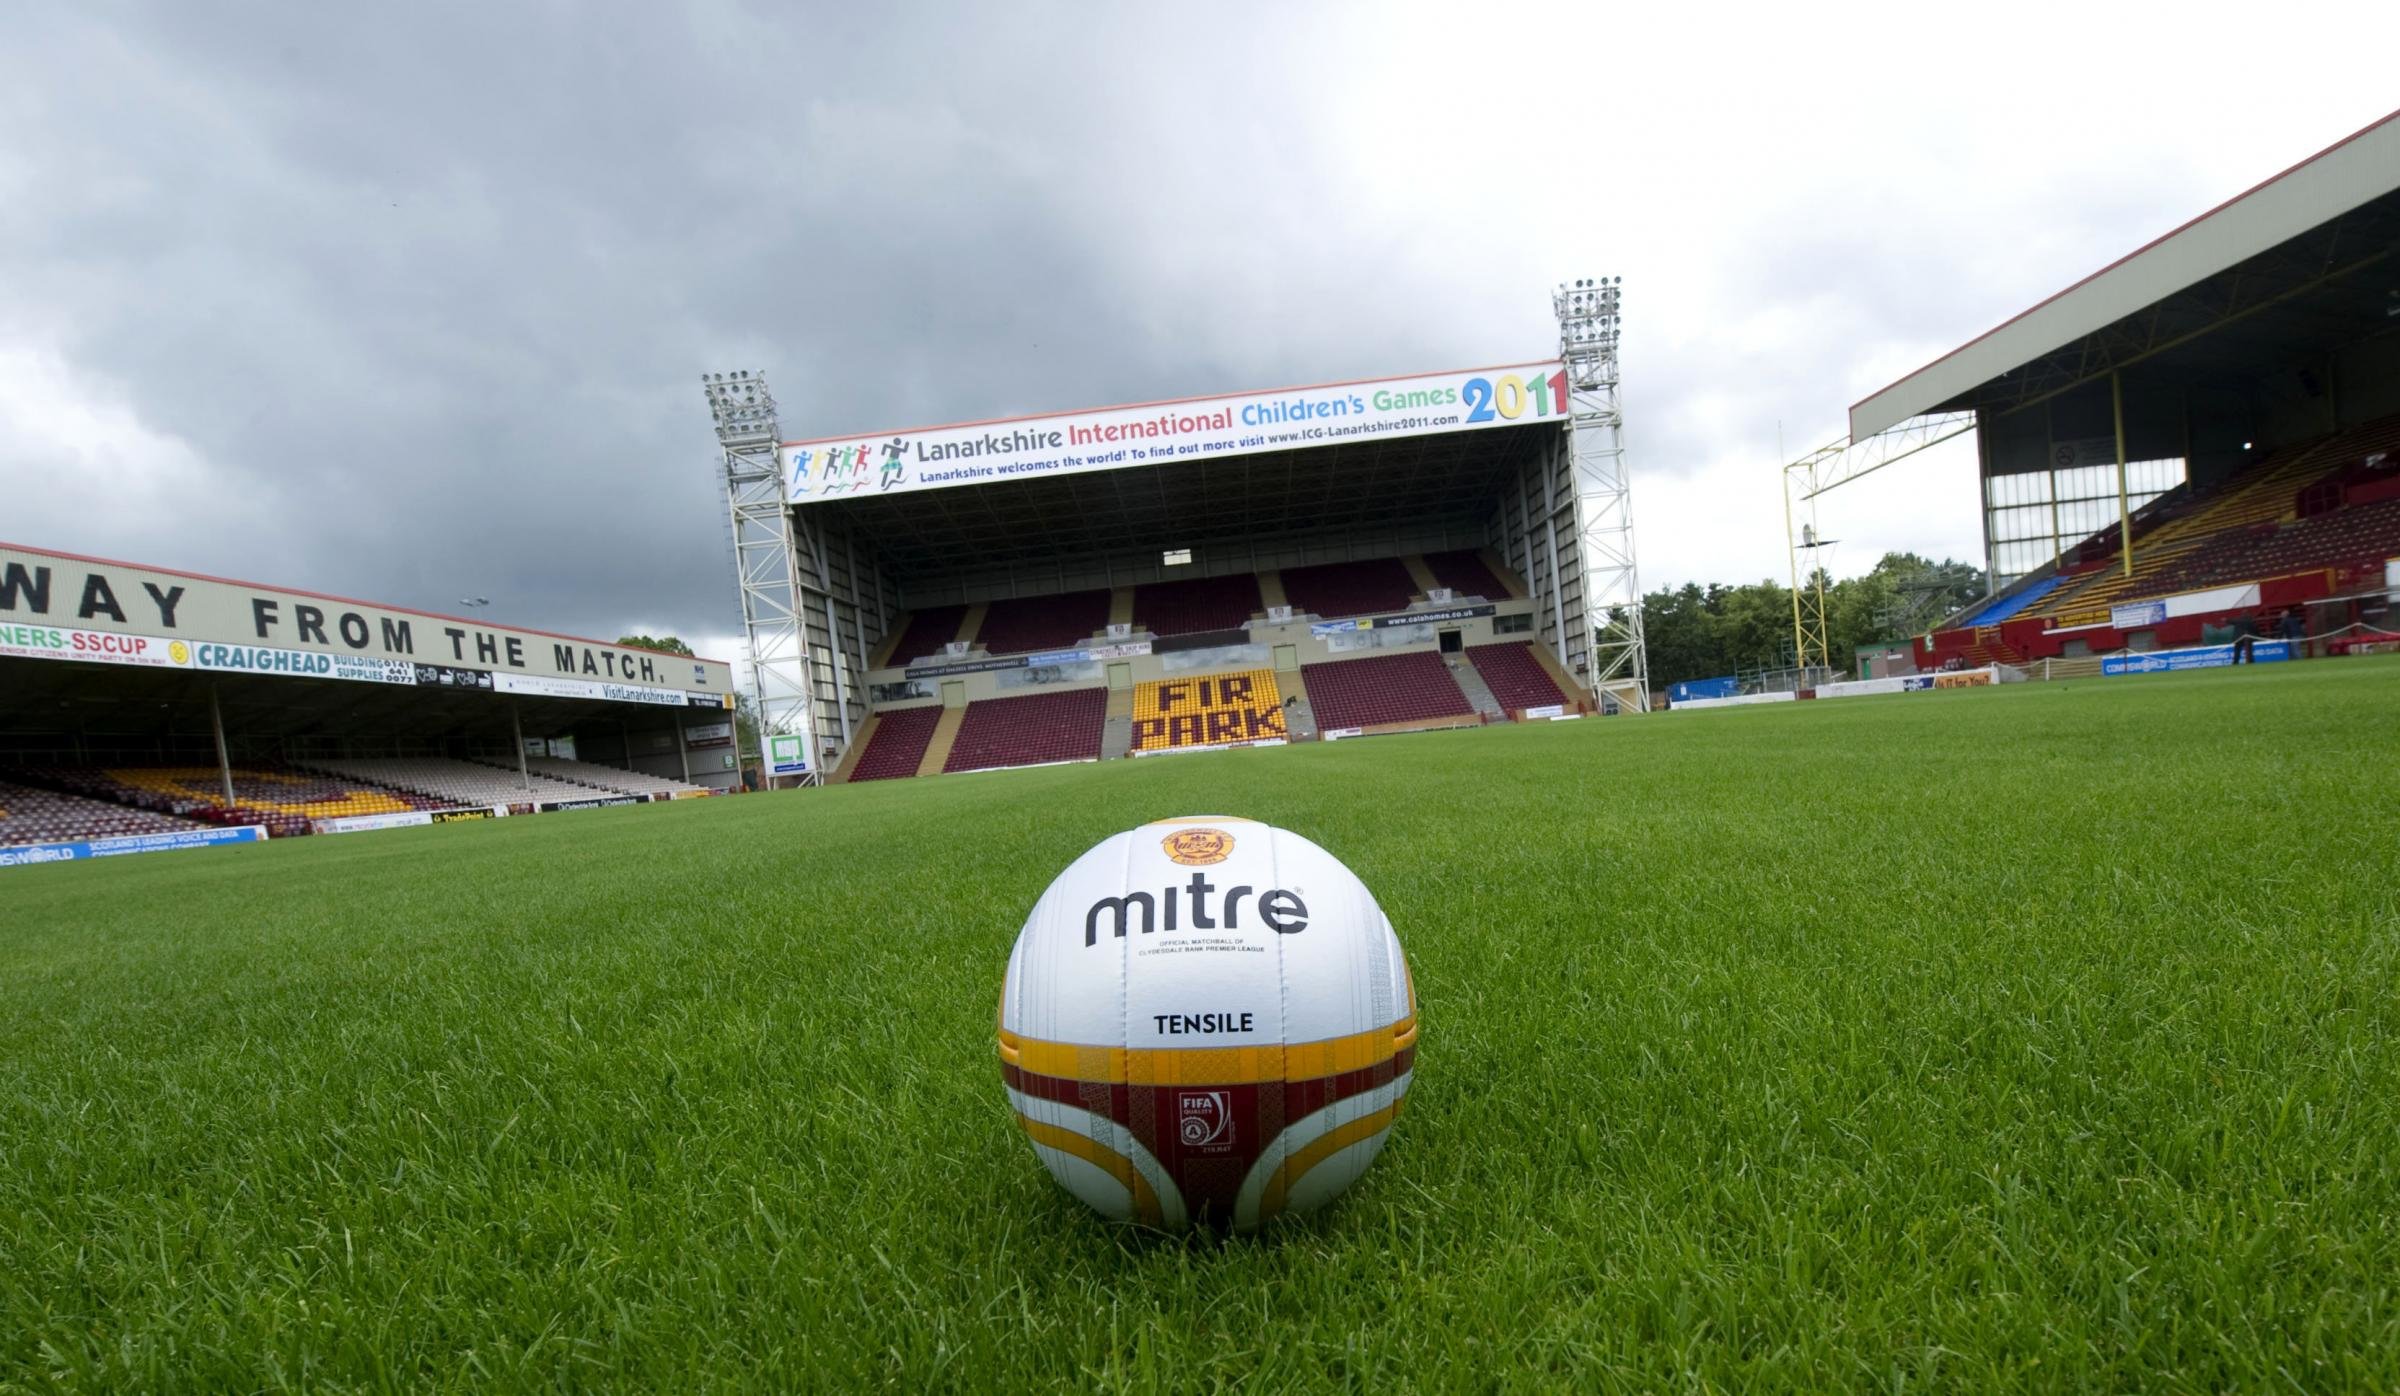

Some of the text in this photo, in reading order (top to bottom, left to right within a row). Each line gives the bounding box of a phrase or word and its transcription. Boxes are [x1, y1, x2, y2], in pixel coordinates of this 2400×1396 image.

[917, 369, 1568, 463] Lanarkshire International Children's Games 2011
[920, 414, 1459, 483] Lanarkshire welcomes the world! To find out more visit www.ICG-Lanarkshire2011.com
[1387, 609, 1474, 625] www.calahomes.co.uk
[252, 597, 414, 655] FROM
[445, 627, 526, 668] THE
[197, 644, 331, 674] CRAIGHEAD
[333, 655, 384, 669] BUILDING
[336, 667, 384, 681] SUPPLIES
[602, 684, 682, 704] VisitLanarkshire.com
[1159, 677, 1254, 711] FIR
[1131, 705, 1288, 750] PARK
[1138, 947, 1182, 956] CLYDESDALE
[1159, 939, 1189, 947] OFFICIAL
[1153, 1012, 1254, 1035] TENSILE
[1183, 1098, 1212, 1109] FIFA
